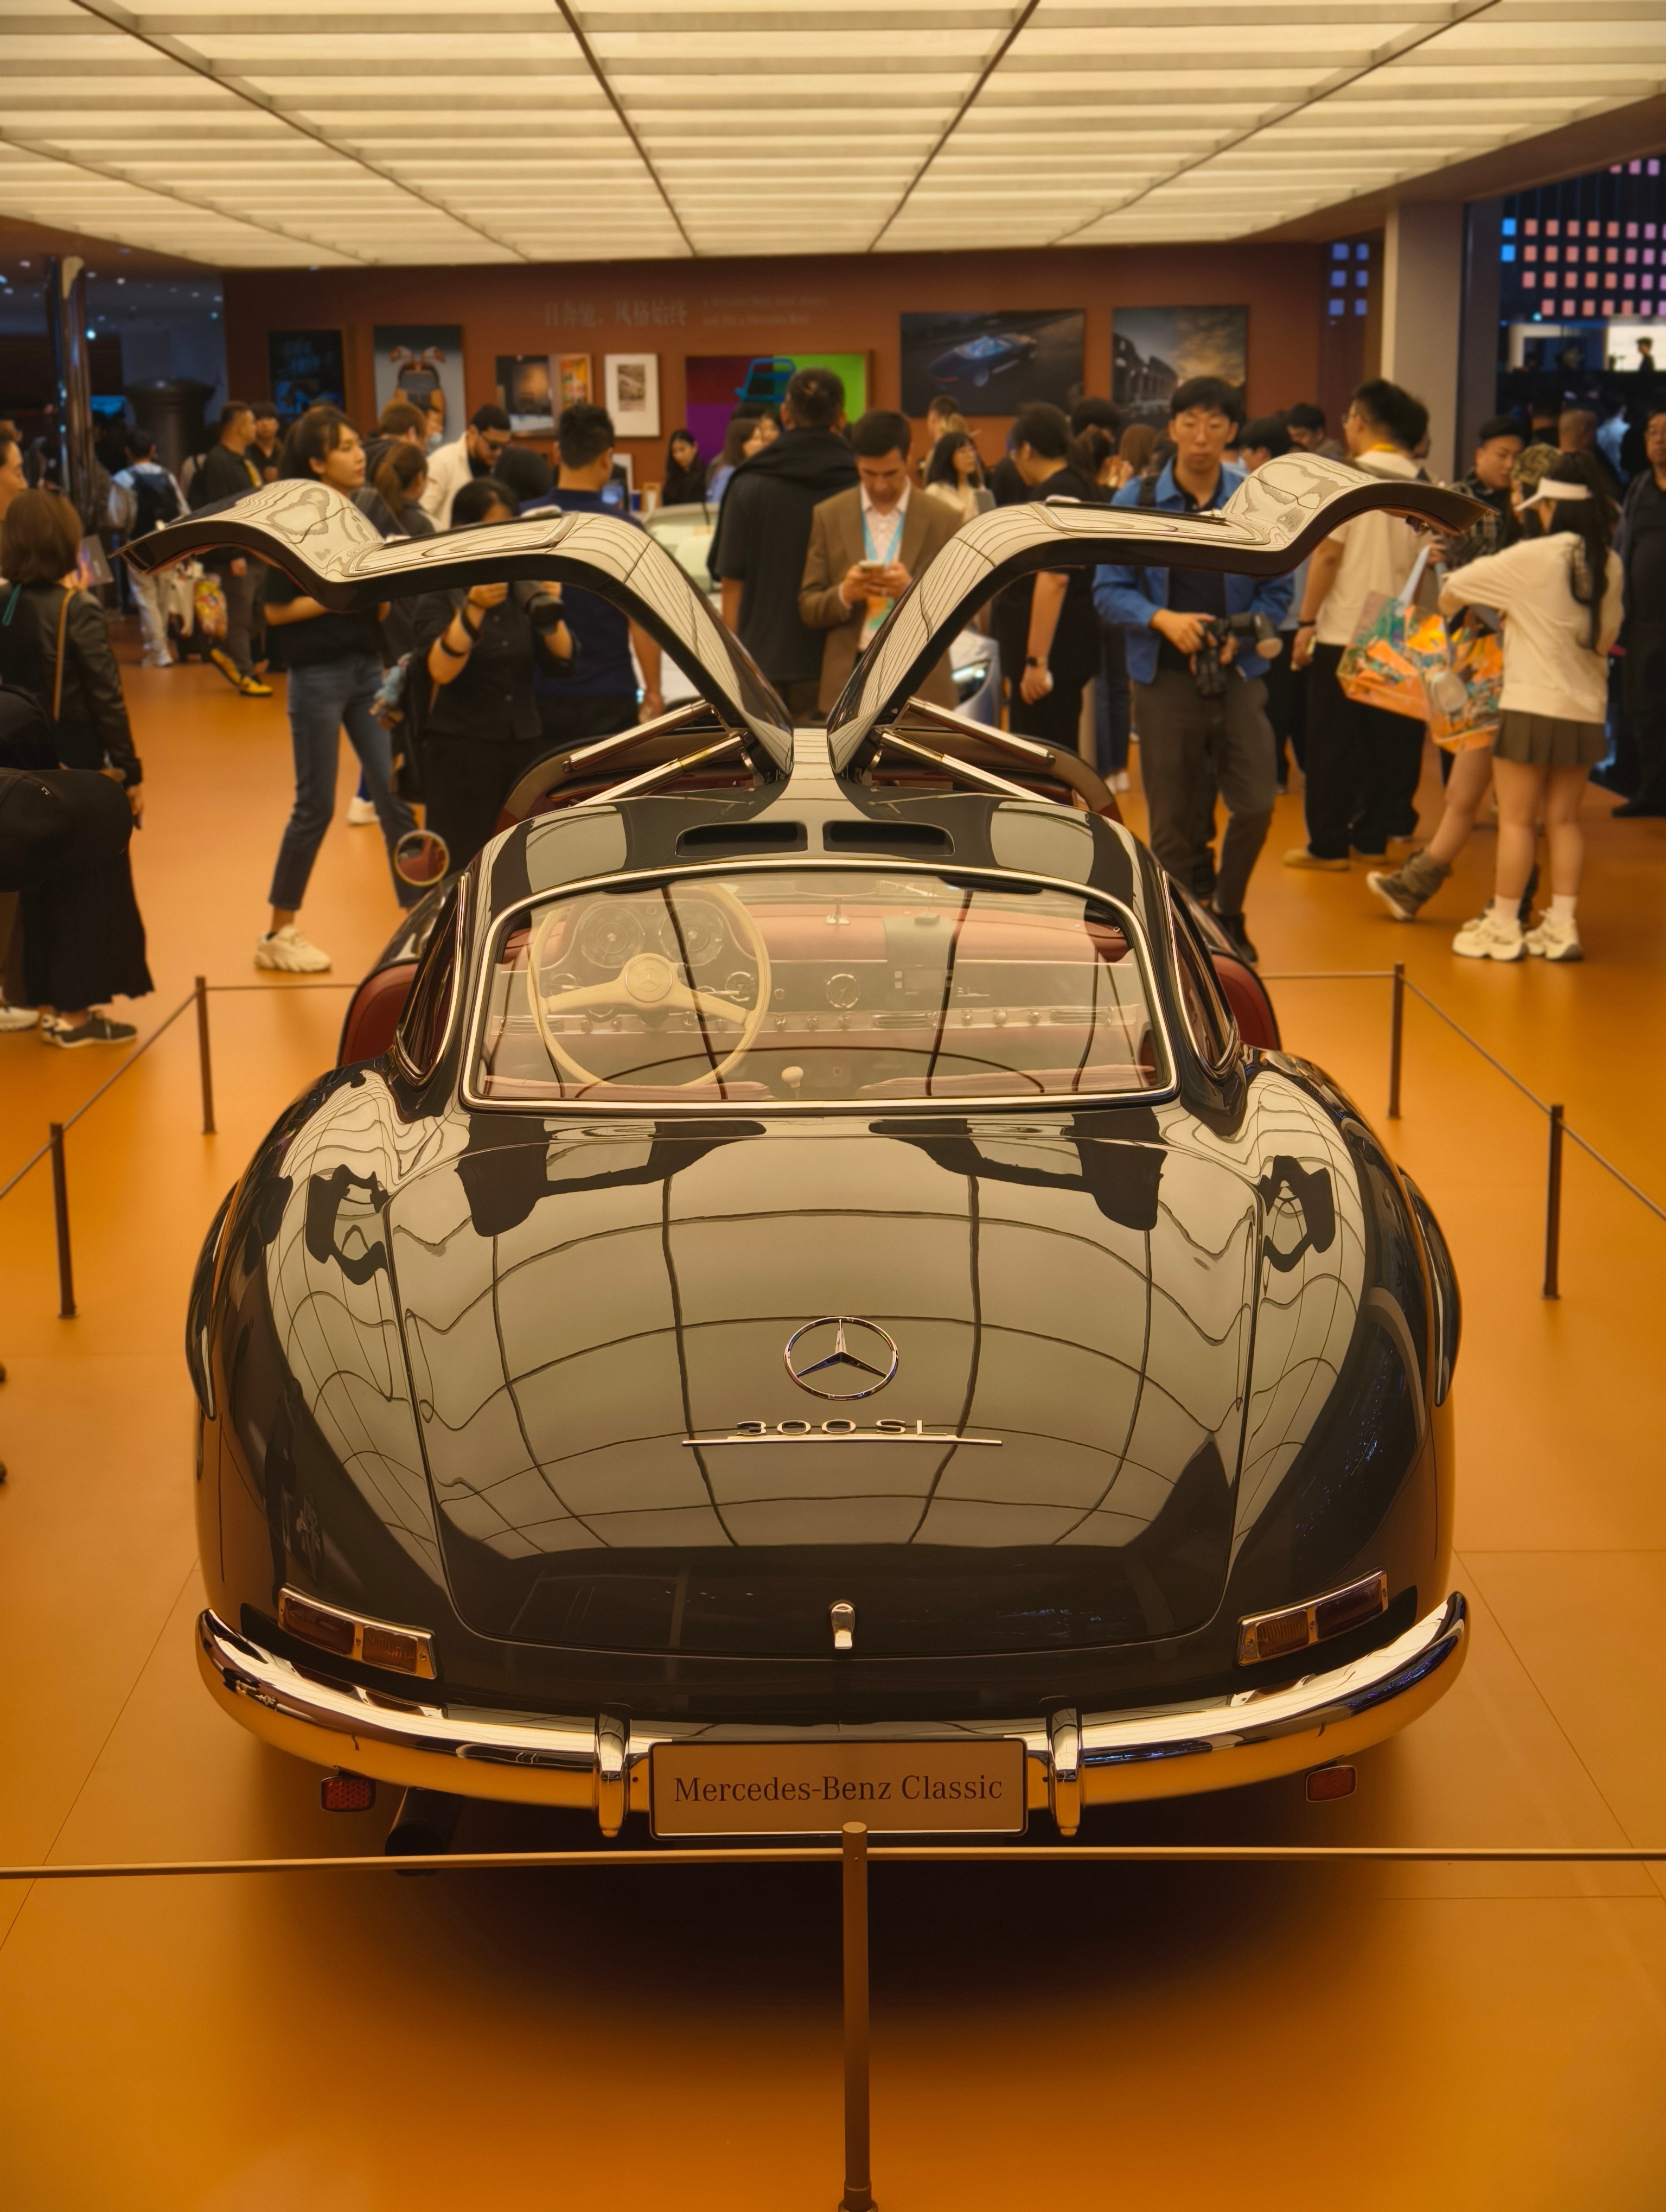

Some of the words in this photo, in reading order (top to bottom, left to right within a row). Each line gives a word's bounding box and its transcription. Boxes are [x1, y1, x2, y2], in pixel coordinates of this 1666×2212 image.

[736, 1419, 857, 1436] 300
[876, 1419, 947, 1436] SL
[674, 1776, 892, 1801] Mercedes-Benz
[902, 1774, 1003, 1799] Classic
